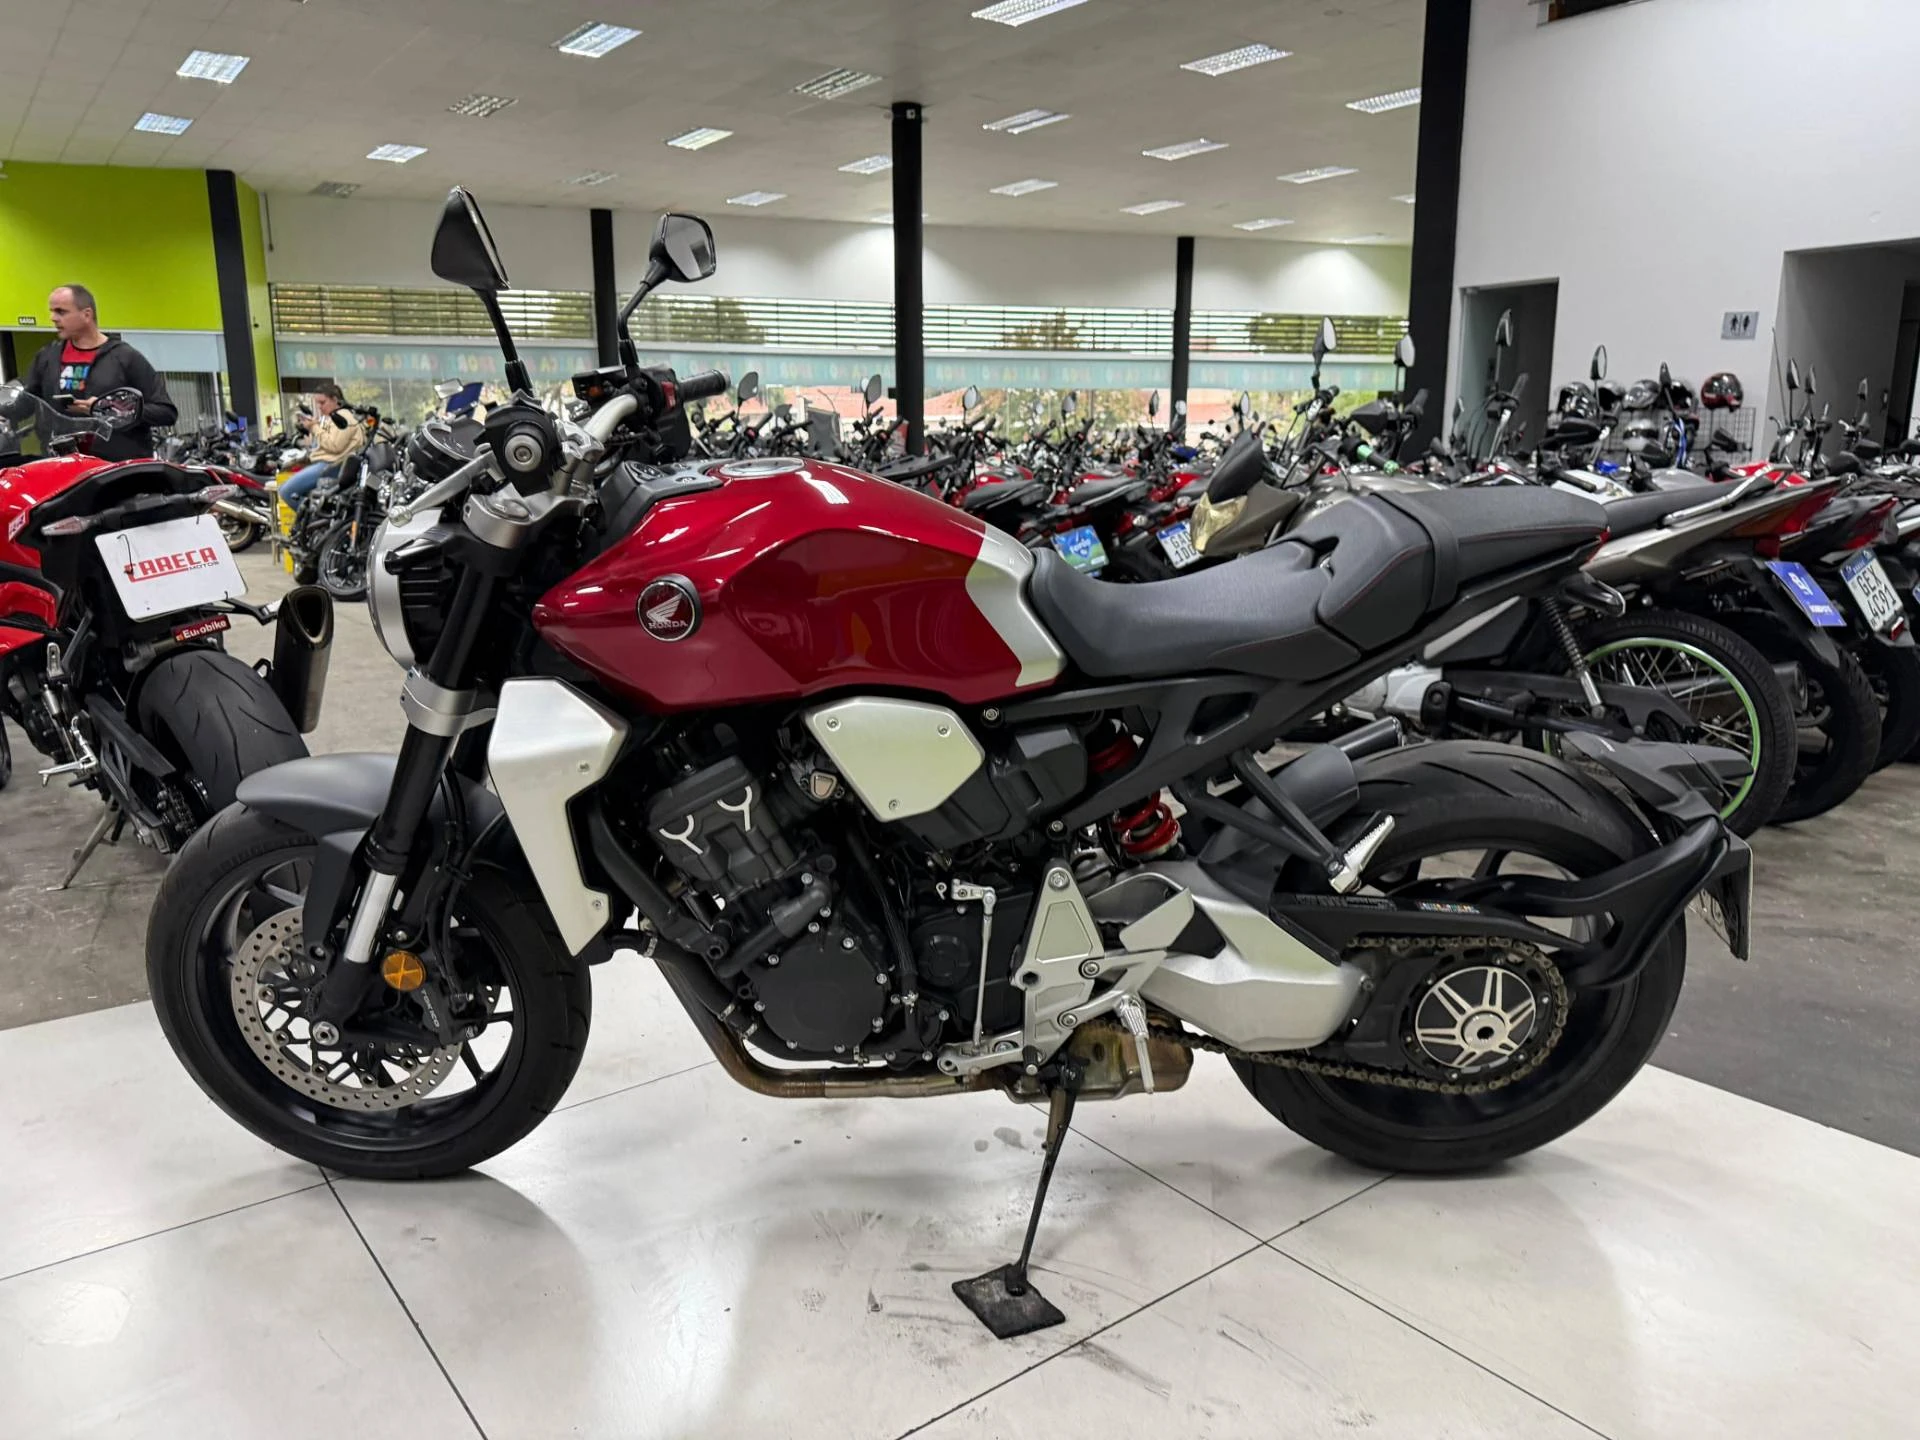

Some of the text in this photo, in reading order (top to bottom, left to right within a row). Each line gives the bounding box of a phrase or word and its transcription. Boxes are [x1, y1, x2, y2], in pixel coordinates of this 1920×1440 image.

[1856, 565, 1882, 597] GEX
[1867, 584, 1897, 619] 4C91
[648, 620, 688, 629] HONDA
